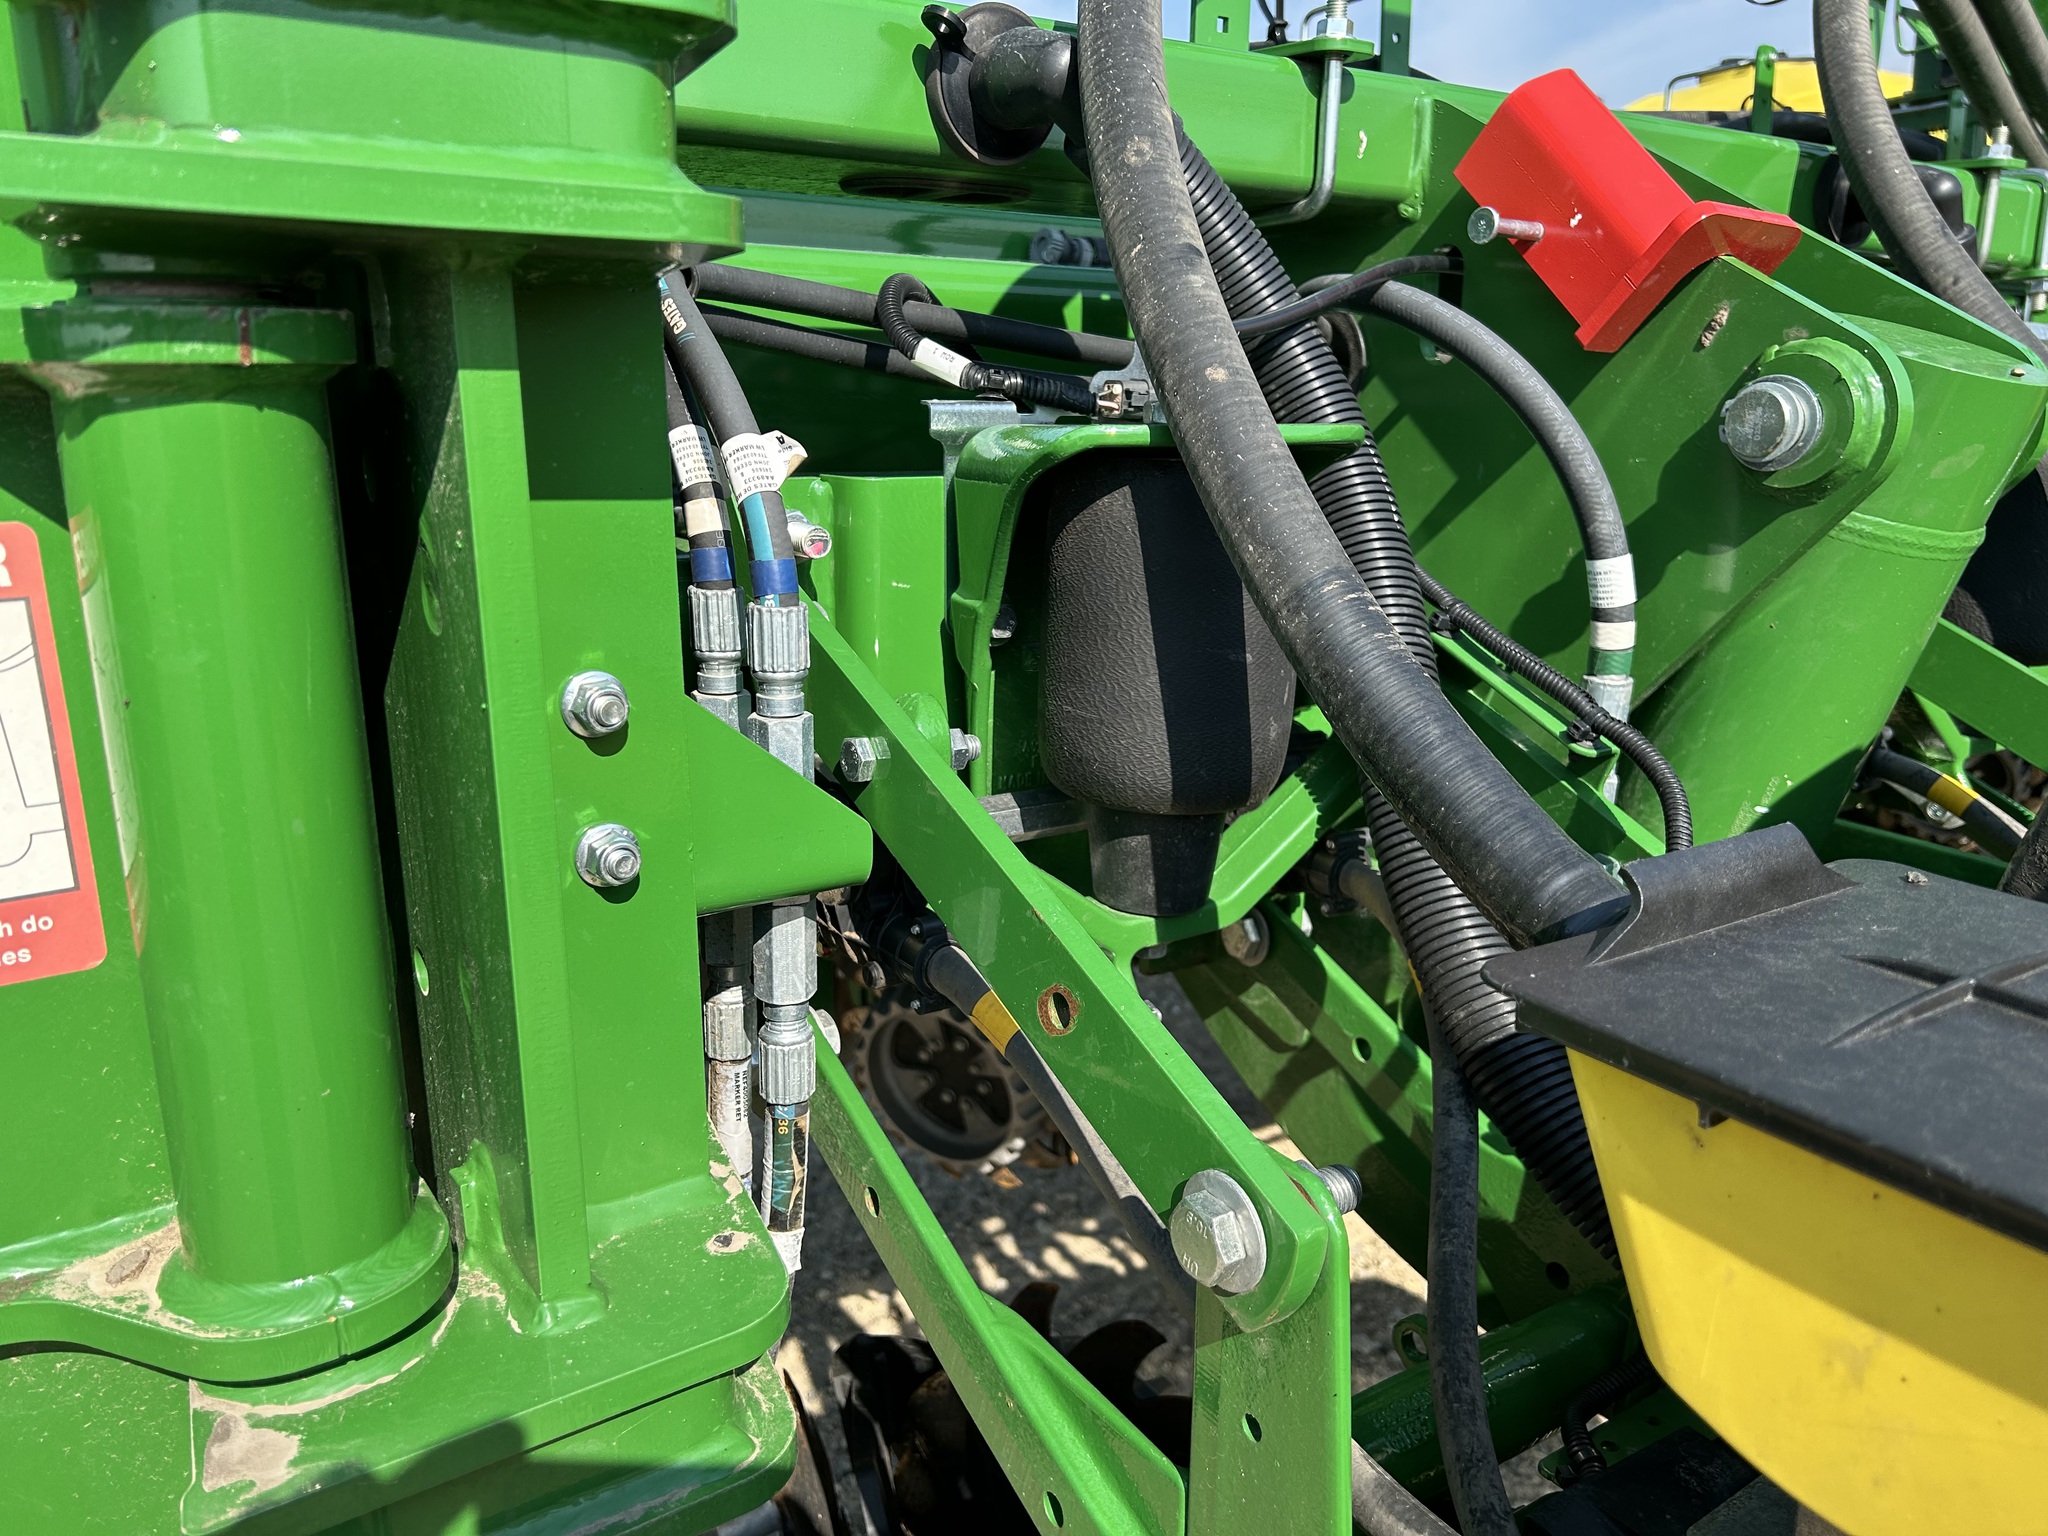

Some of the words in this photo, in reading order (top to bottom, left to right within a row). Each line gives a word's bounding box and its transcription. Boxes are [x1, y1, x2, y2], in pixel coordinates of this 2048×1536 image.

[661, 296, 688, 335] GATES
[939, 350, 955, 363] ROW
[670, 435, 696, 448] MARKER
[774, 434, 786, 445] A
[727, 443, 755, 457] MARKER
[675, 451, 694, 463] DEERE
[732, 460, 752, 473] DEERE
[683, 476, 693, 484] DE
[742, 474, 774, 484] AA89333
[742, 485, 752, 494] DE
[21, 914, 54, 934] do
[0, 948, 32, 967] es
[733, 1072, 741, 1105] MARKER
[777, 1118, 788, 1134] 36
